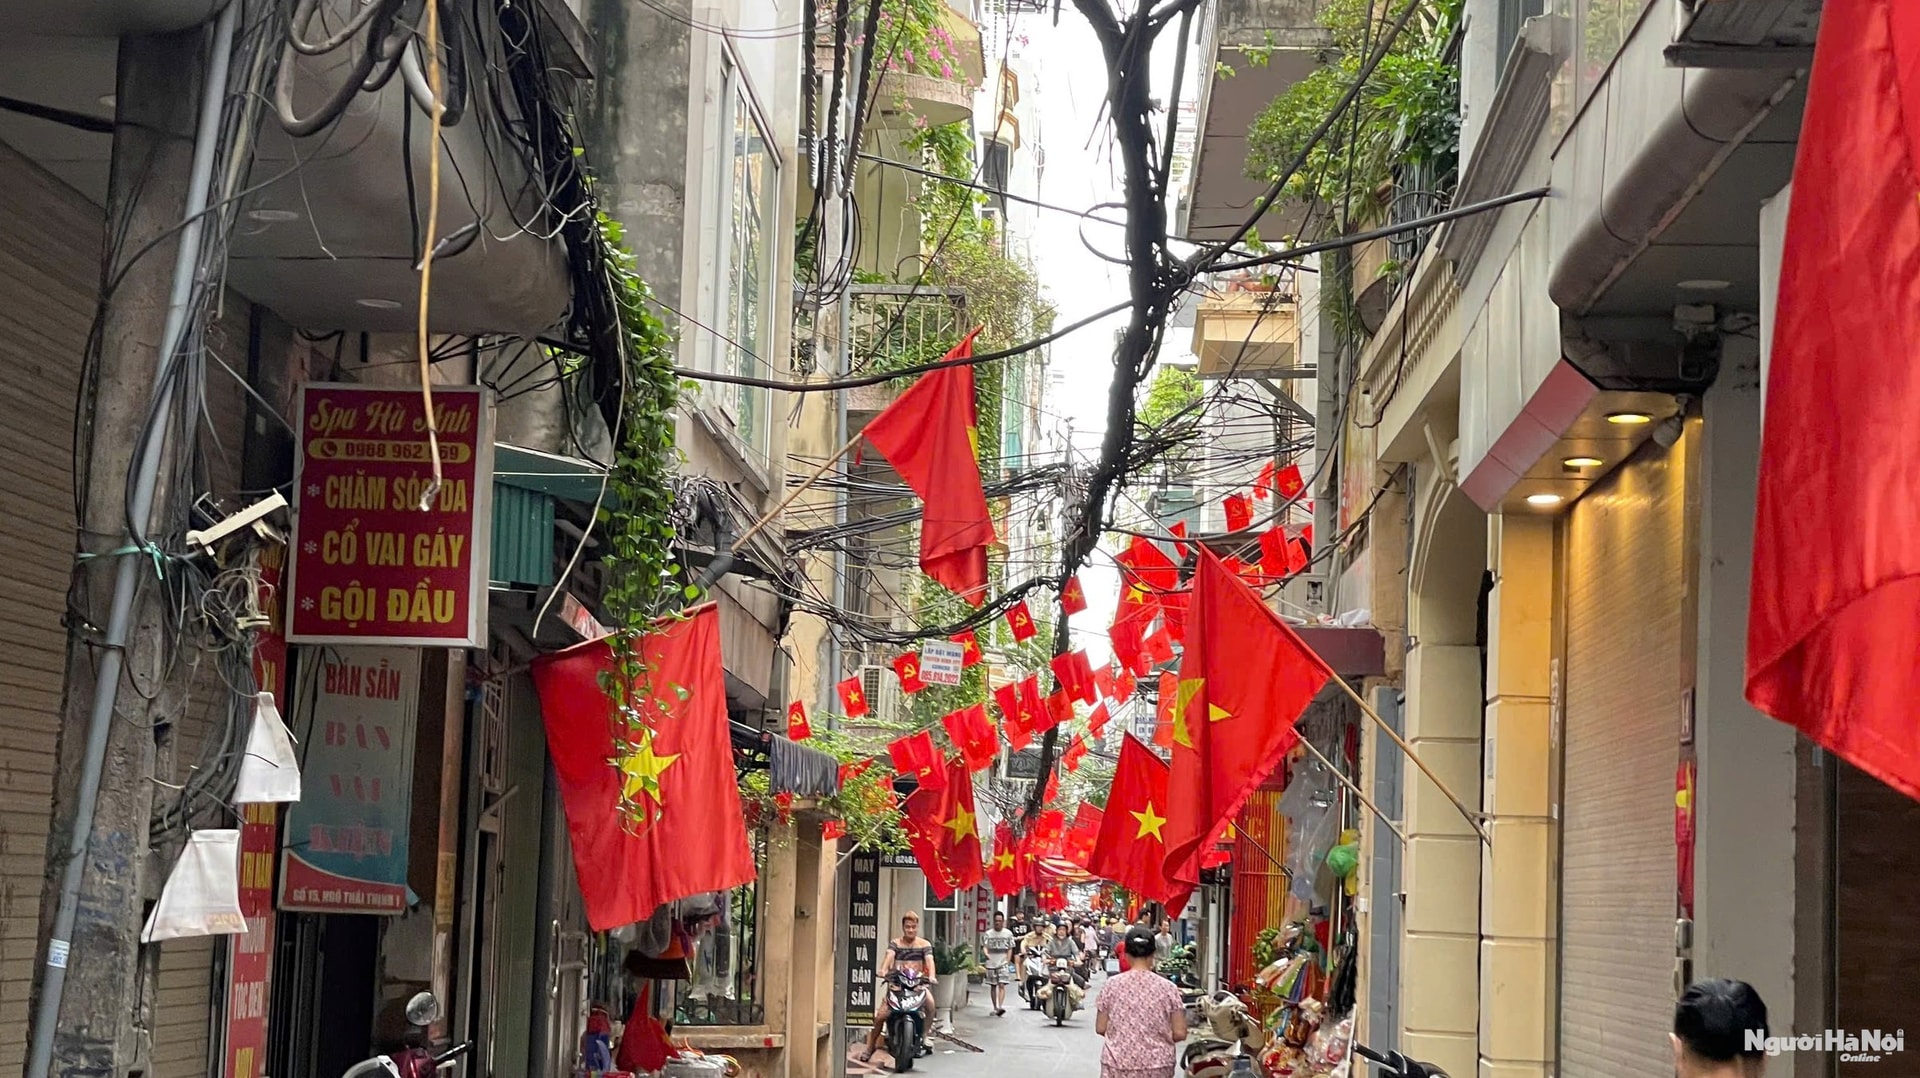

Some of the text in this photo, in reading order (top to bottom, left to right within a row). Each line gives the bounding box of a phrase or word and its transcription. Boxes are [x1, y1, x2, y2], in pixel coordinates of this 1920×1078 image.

[309, 398, 358, 438] Spa
[365, 401, 406, 435] Hà
[392, 444, 423, 460] 962
[324, 469, 387, 510] CHĂM
[440, 479, 467, 512] DA
[322, 518, 360, 566] CỔ
[365, 531, 405, 566] VAI
[412, 527, 465, 568] GÁY
[320, 580, 377, 629] GỘI
[386, 577, 455, 624] ĐẦU
[325, 658, 400, 700] BÁN SẴN
[854, 858, 874, 873] MAY
[850, 924, 876, 939] TRANG
[856, 944, 868, 961] VÀ
[851, 966, 871, 984] BÁN
[234, 974, 248, 1020] TÓC
